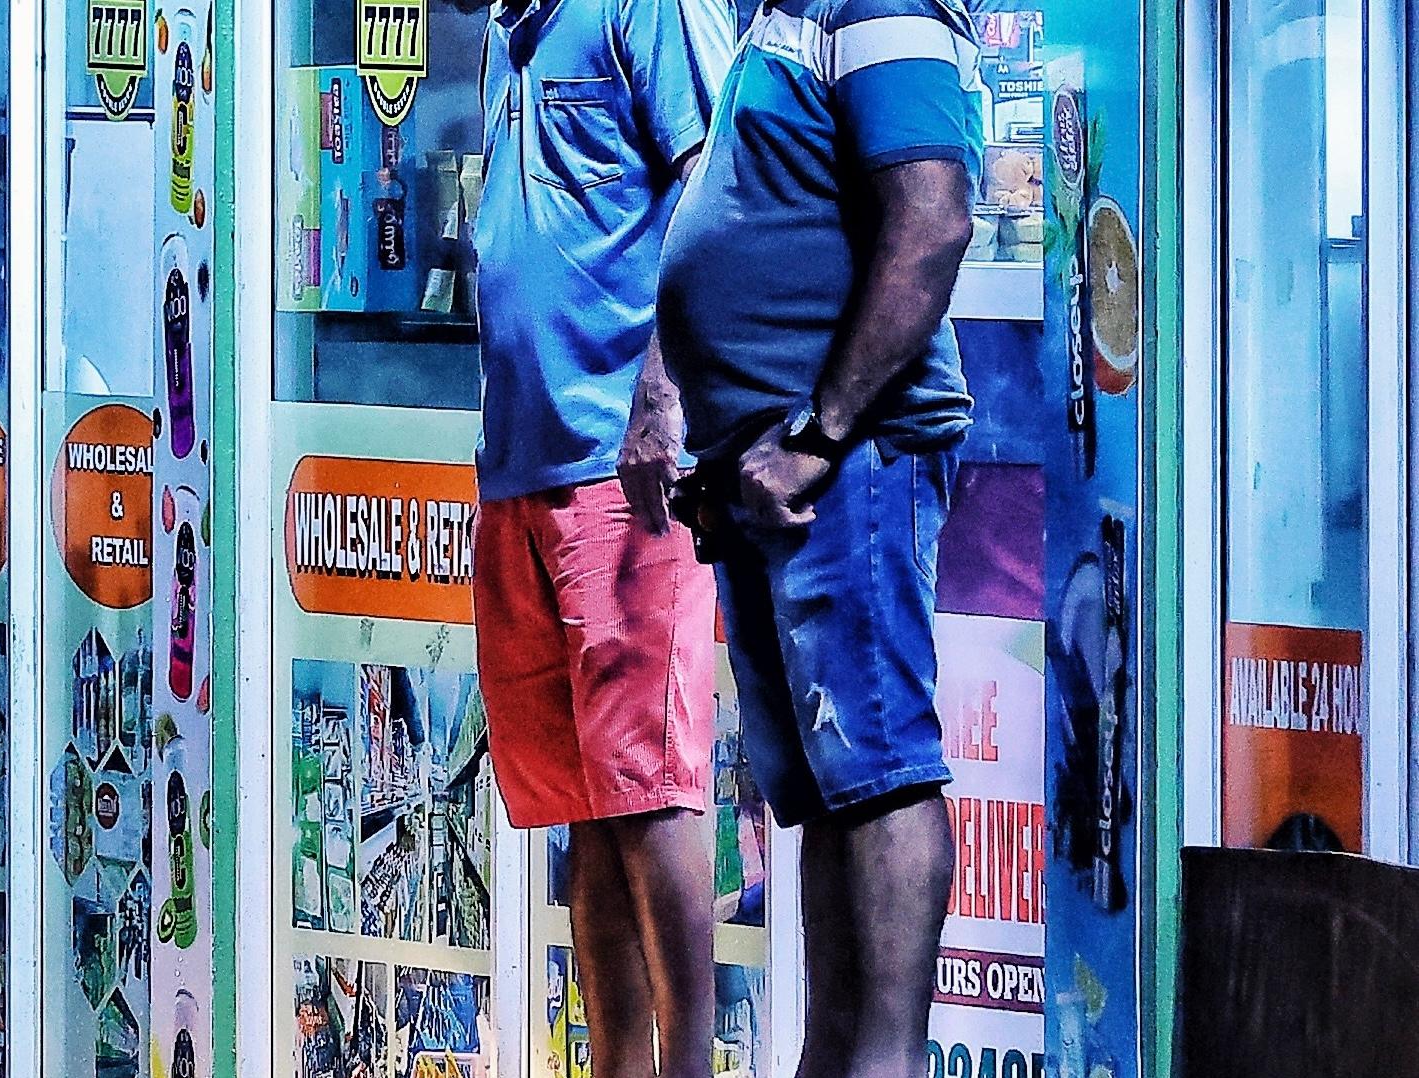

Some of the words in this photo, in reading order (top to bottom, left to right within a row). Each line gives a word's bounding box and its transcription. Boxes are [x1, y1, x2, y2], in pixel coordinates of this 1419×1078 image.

[92, 7, 141, 56] 7777
[364, 6, 420, 57] 7777
[67, 442, 153, 473] WHOLESAL
[111, 491, 124, 519] &
[91, 536, 149, 567] RETAIL
[295, 491, 403, 577] WHOLESALE
[408, 498, 421, 580] &
[1231, 657, 1307, 731] AVAILABLE
[1311, 661, 1329, 732] 24
